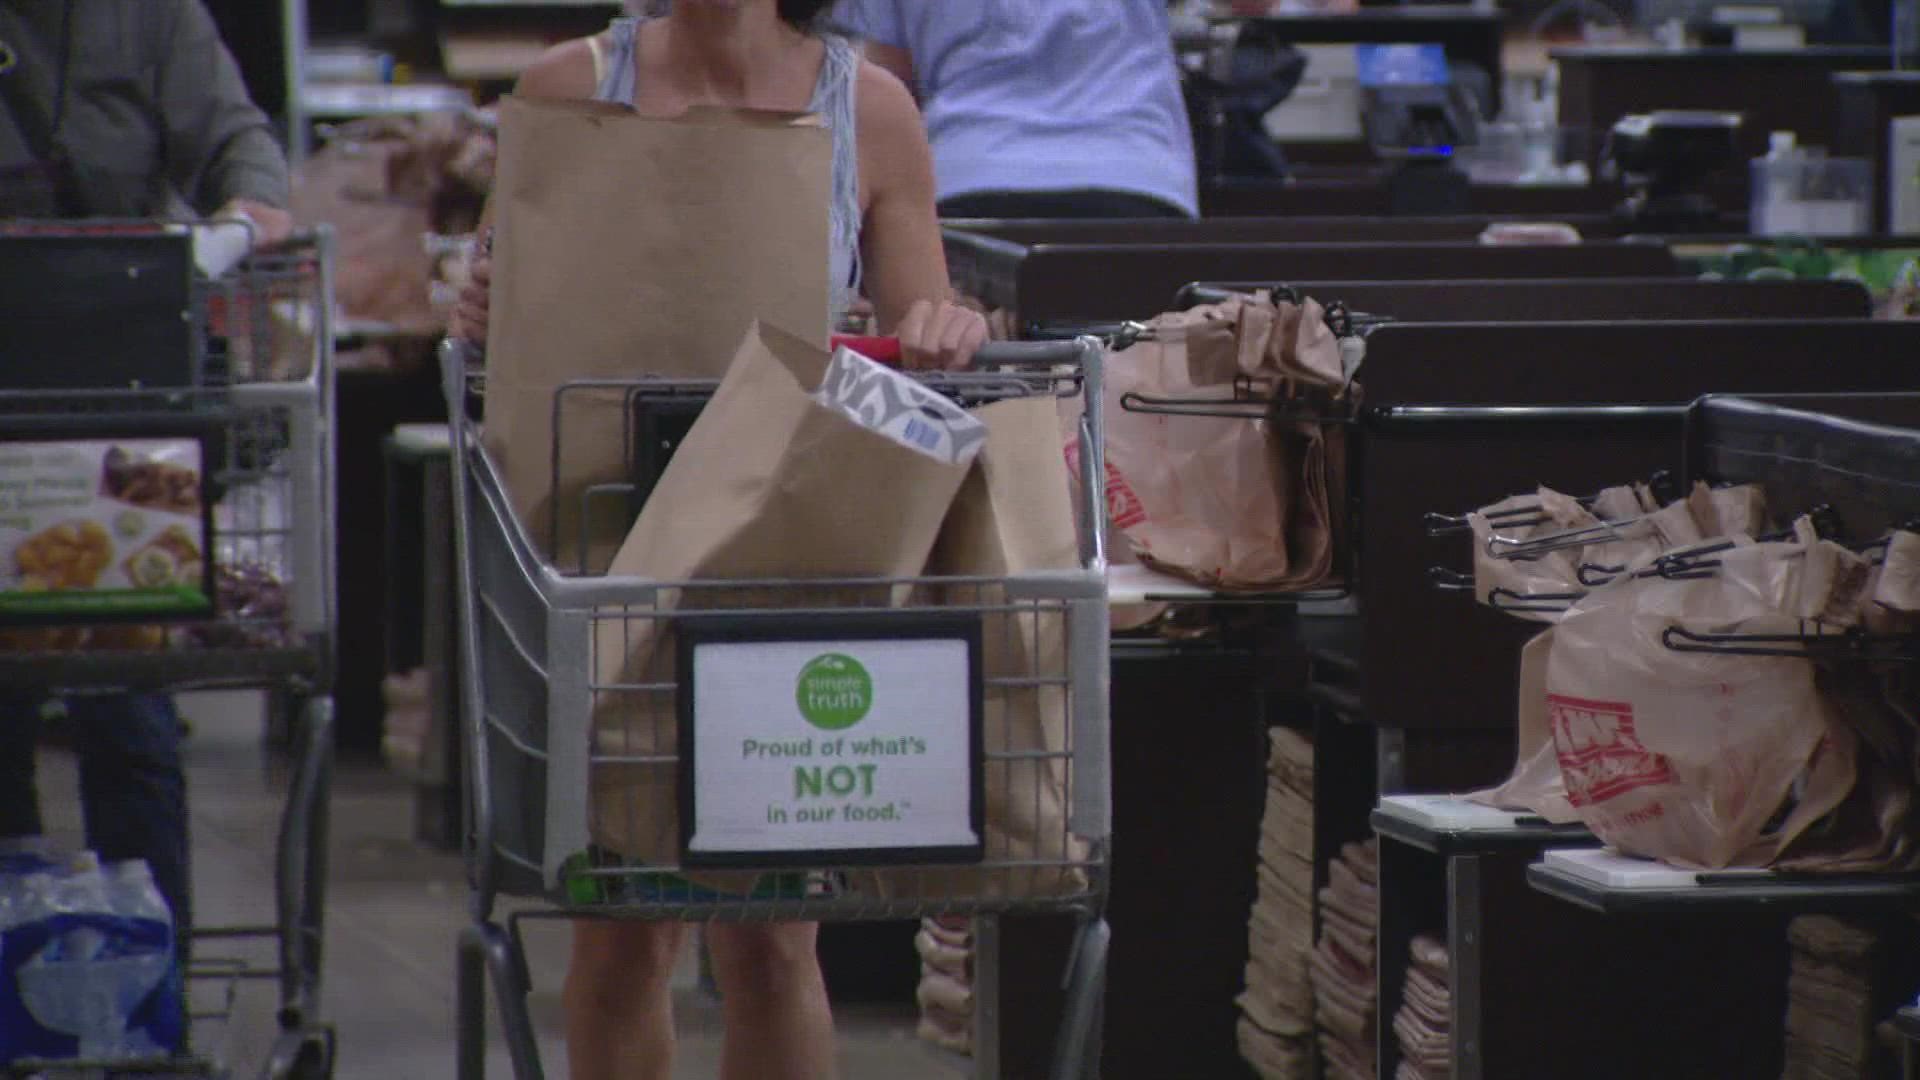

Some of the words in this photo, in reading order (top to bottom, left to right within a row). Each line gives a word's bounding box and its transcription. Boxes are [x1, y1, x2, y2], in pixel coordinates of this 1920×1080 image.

[806, 677, 863, 693] simple
[808, 691, 863, 709] truth
[742, 739, 812, 759] Proud
[820, 738, 843, 757] of
[851, 736, 926, 756] what's
[795, 764, 877, 798] NOT
[767, 804, 787, 824] in
[796, 808, 834, 823] our
